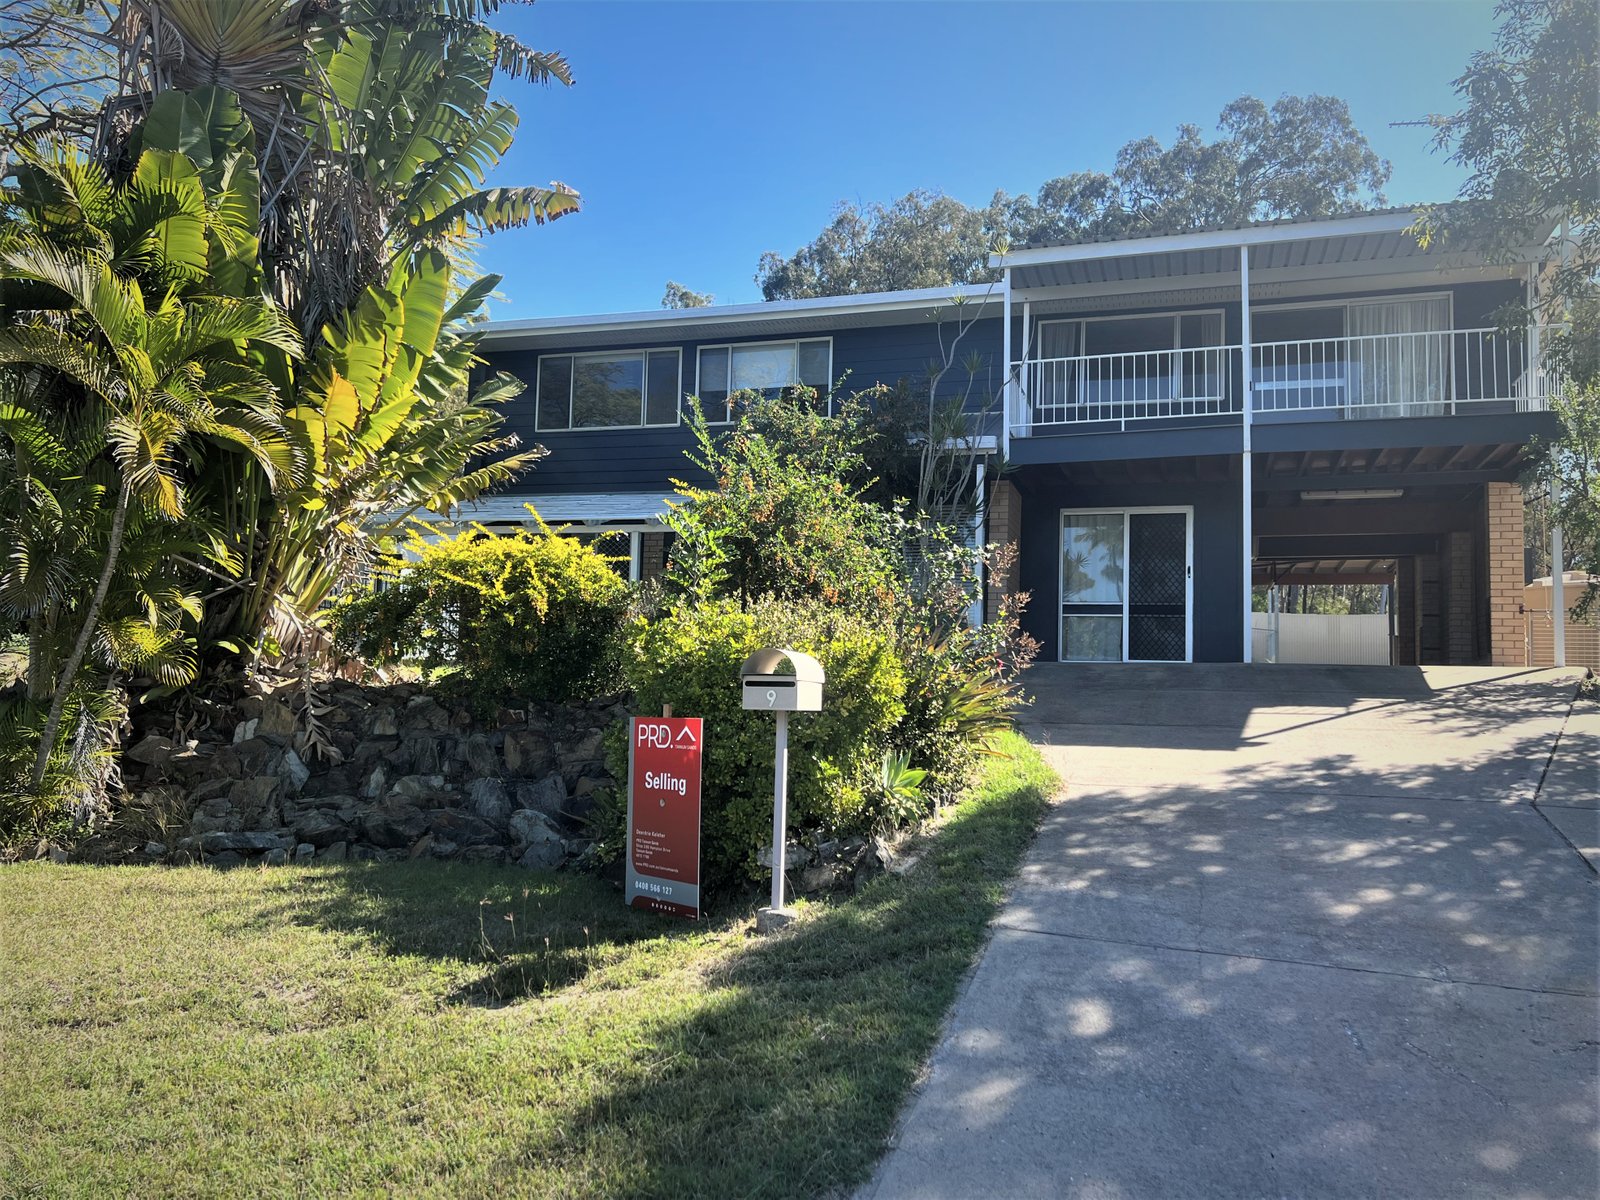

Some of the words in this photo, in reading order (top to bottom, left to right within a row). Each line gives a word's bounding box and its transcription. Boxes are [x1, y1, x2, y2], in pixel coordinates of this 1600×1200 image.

[766, 689, 777, 708] 9
[645, 771, 687, 796] Selling
[634, 880, 649, 891] 0408
[650, 883, 661, 893] 566
[662, 886, 673, 896] 127
